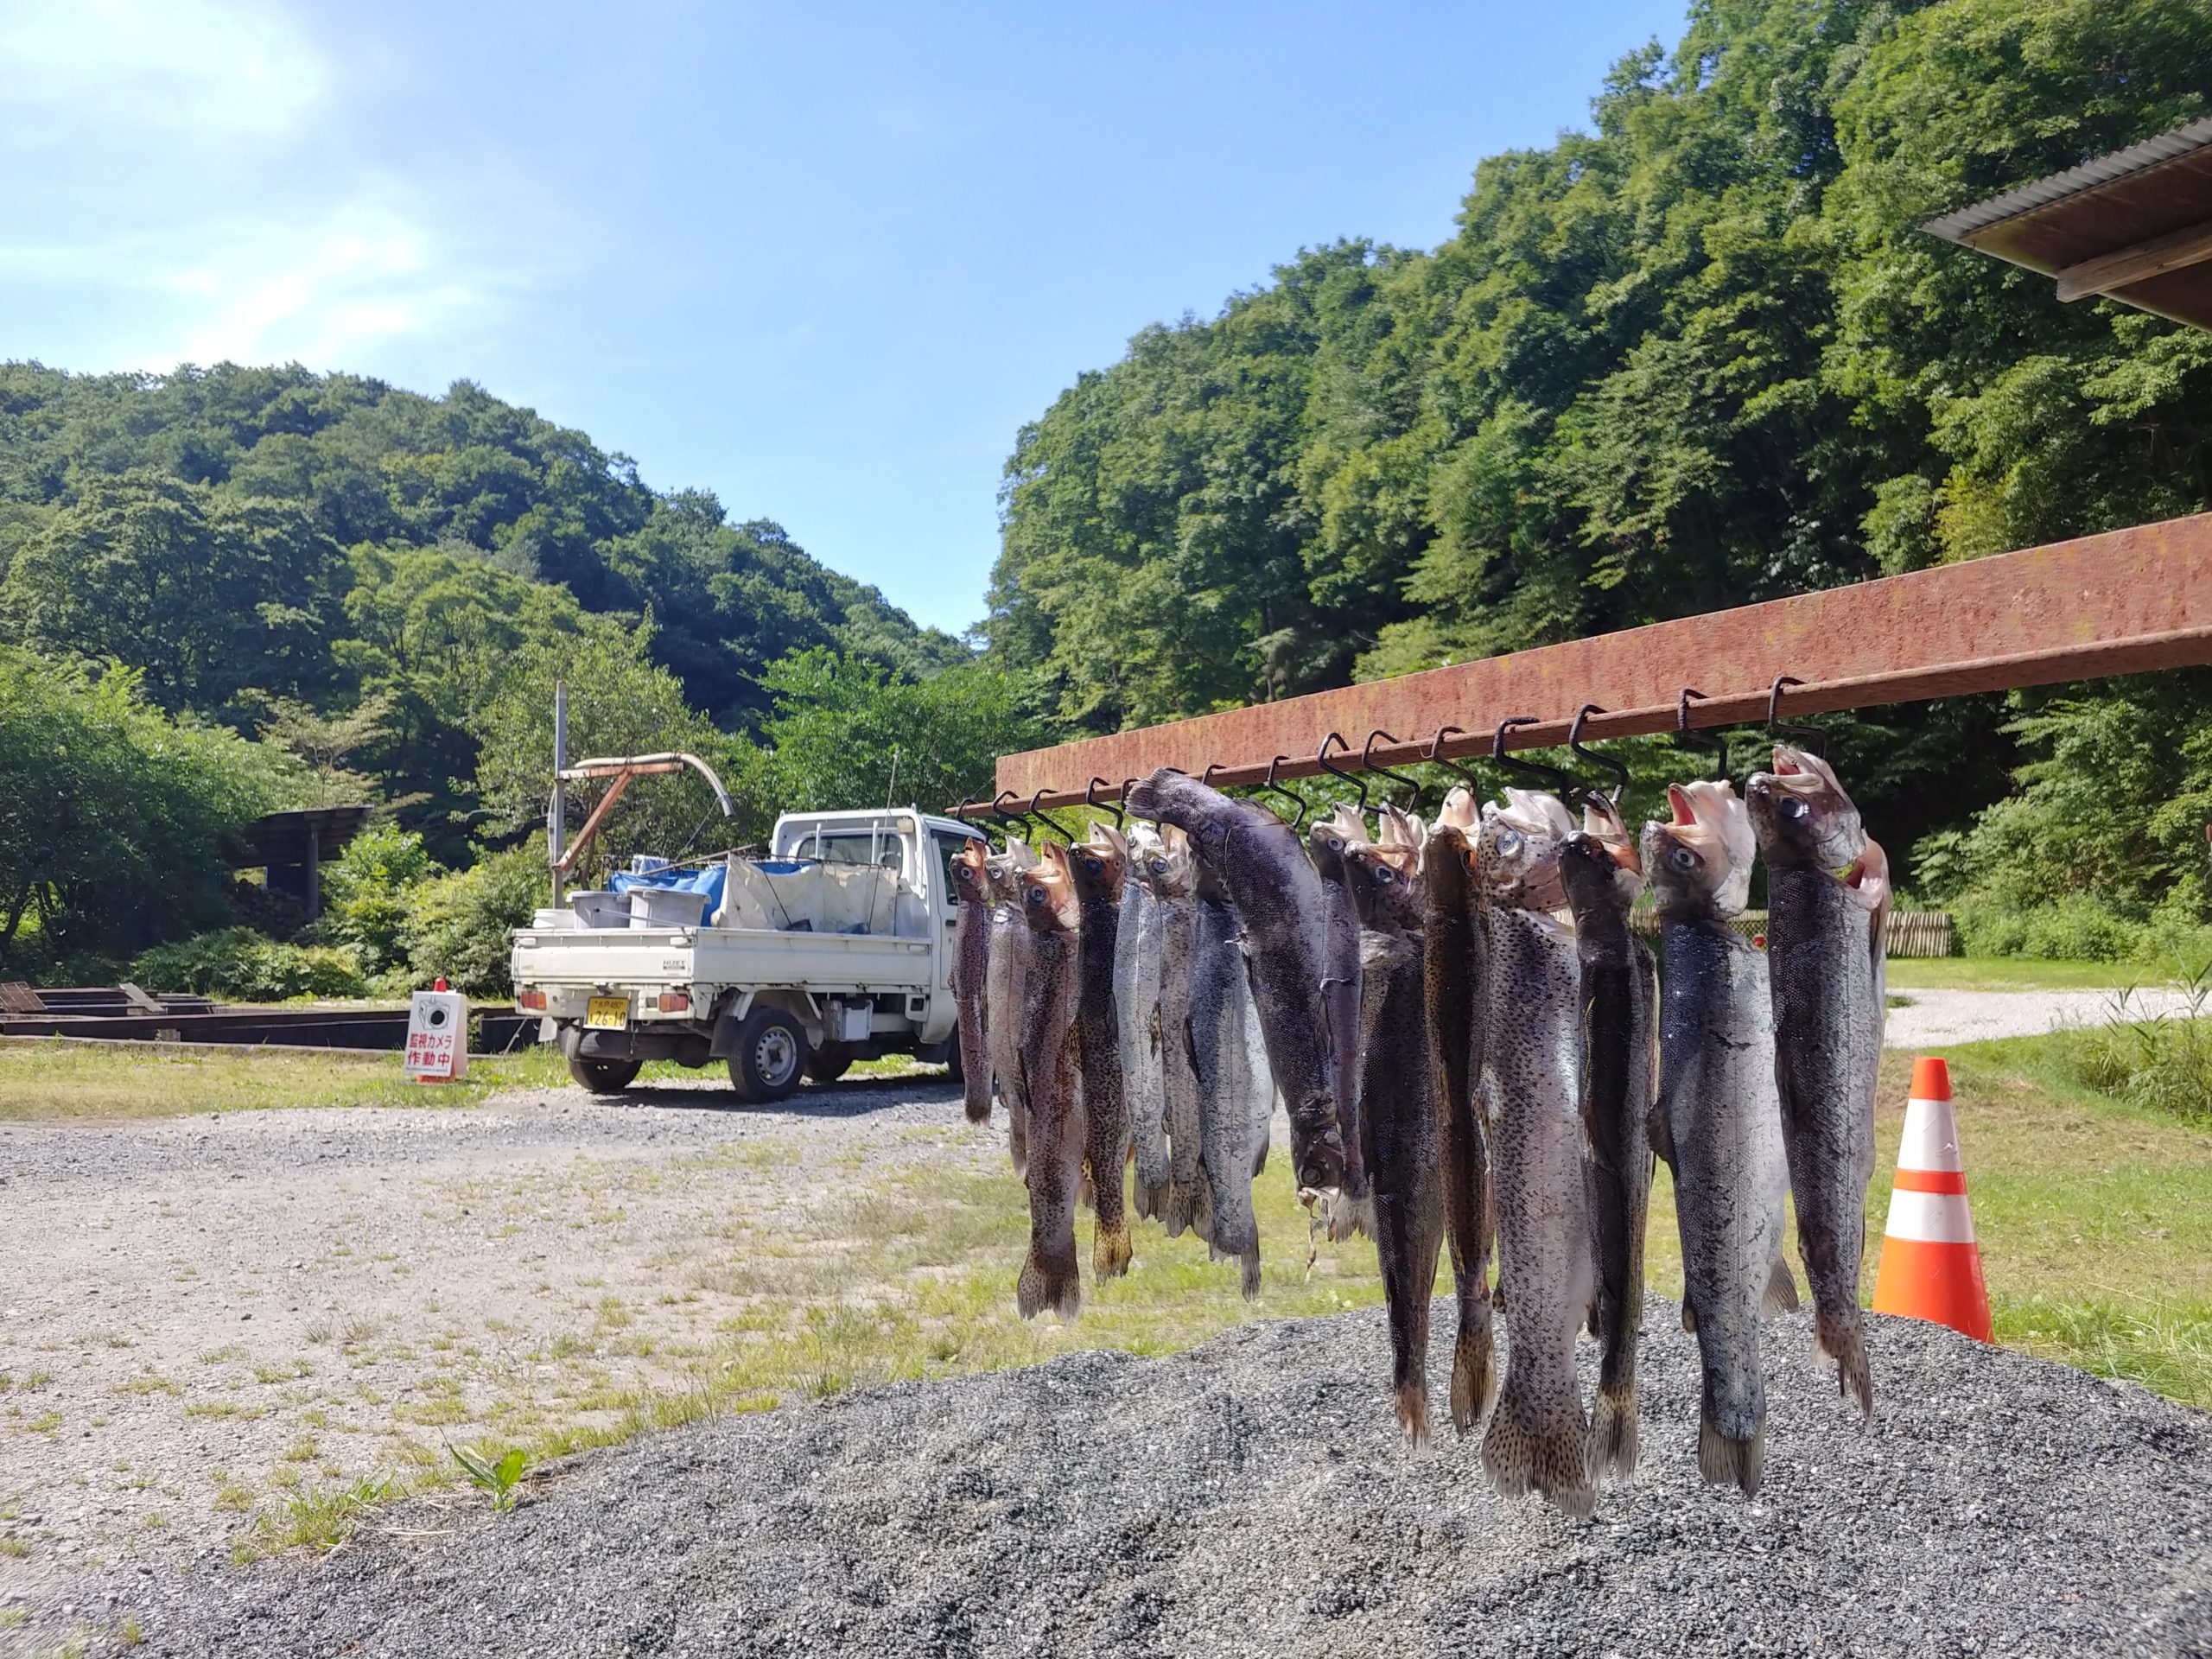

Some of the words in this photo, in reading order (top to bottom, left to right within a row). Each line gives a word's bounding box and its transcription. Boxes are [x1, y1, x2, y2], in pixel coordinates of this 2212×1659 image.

[409, 1033, 452, 1049] 監視カメラ
[407, 1050, 450, 1067] 作動中
